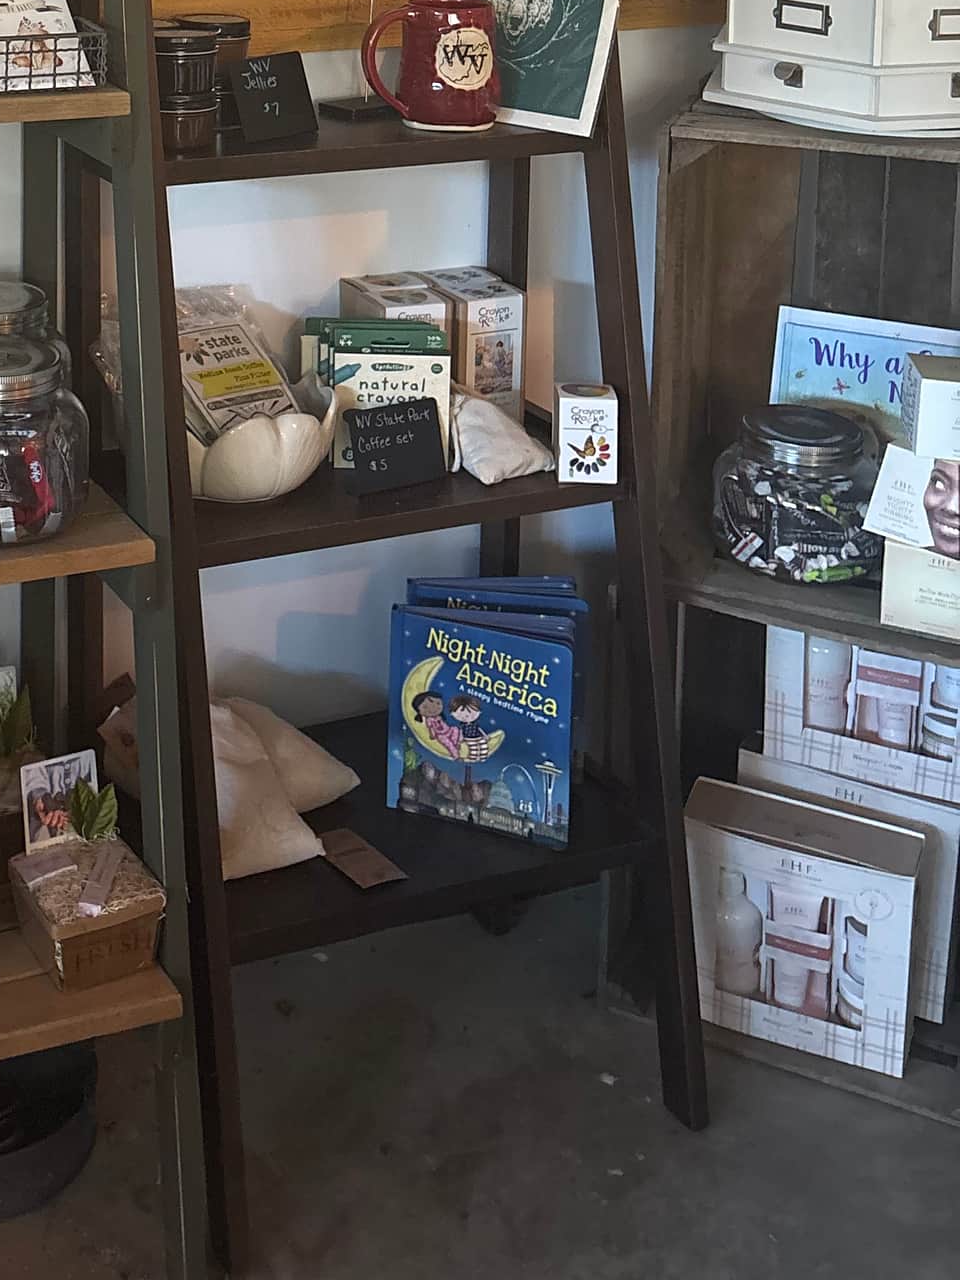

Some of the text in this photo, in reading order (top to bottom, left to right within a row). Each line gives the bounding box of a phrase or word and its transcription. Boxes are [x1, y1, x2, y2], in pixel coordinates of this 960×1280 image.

[248, 57, 271, 75] WV
[241, 72, 278, 91] Jellies
[478, 305, 511, 318] Crayon
[205, 334, 242, 350] state
[212, 346, 251, 363] parks
[808, 336, 905, 385] Why a
[359, 376, 426, 393] natural
[374, 413, 406, 428] State
[407, 407, 431, 422] Park
[570, 405, 606, 418] Crayon
[357, 430, 415, 454] Coffee set
[455, 663, 558, 718] America
[466, 687, 492, 703] sleepy
[493, 697, 525, 716] bedtime
[526, 709, 550, 725] rhyme
